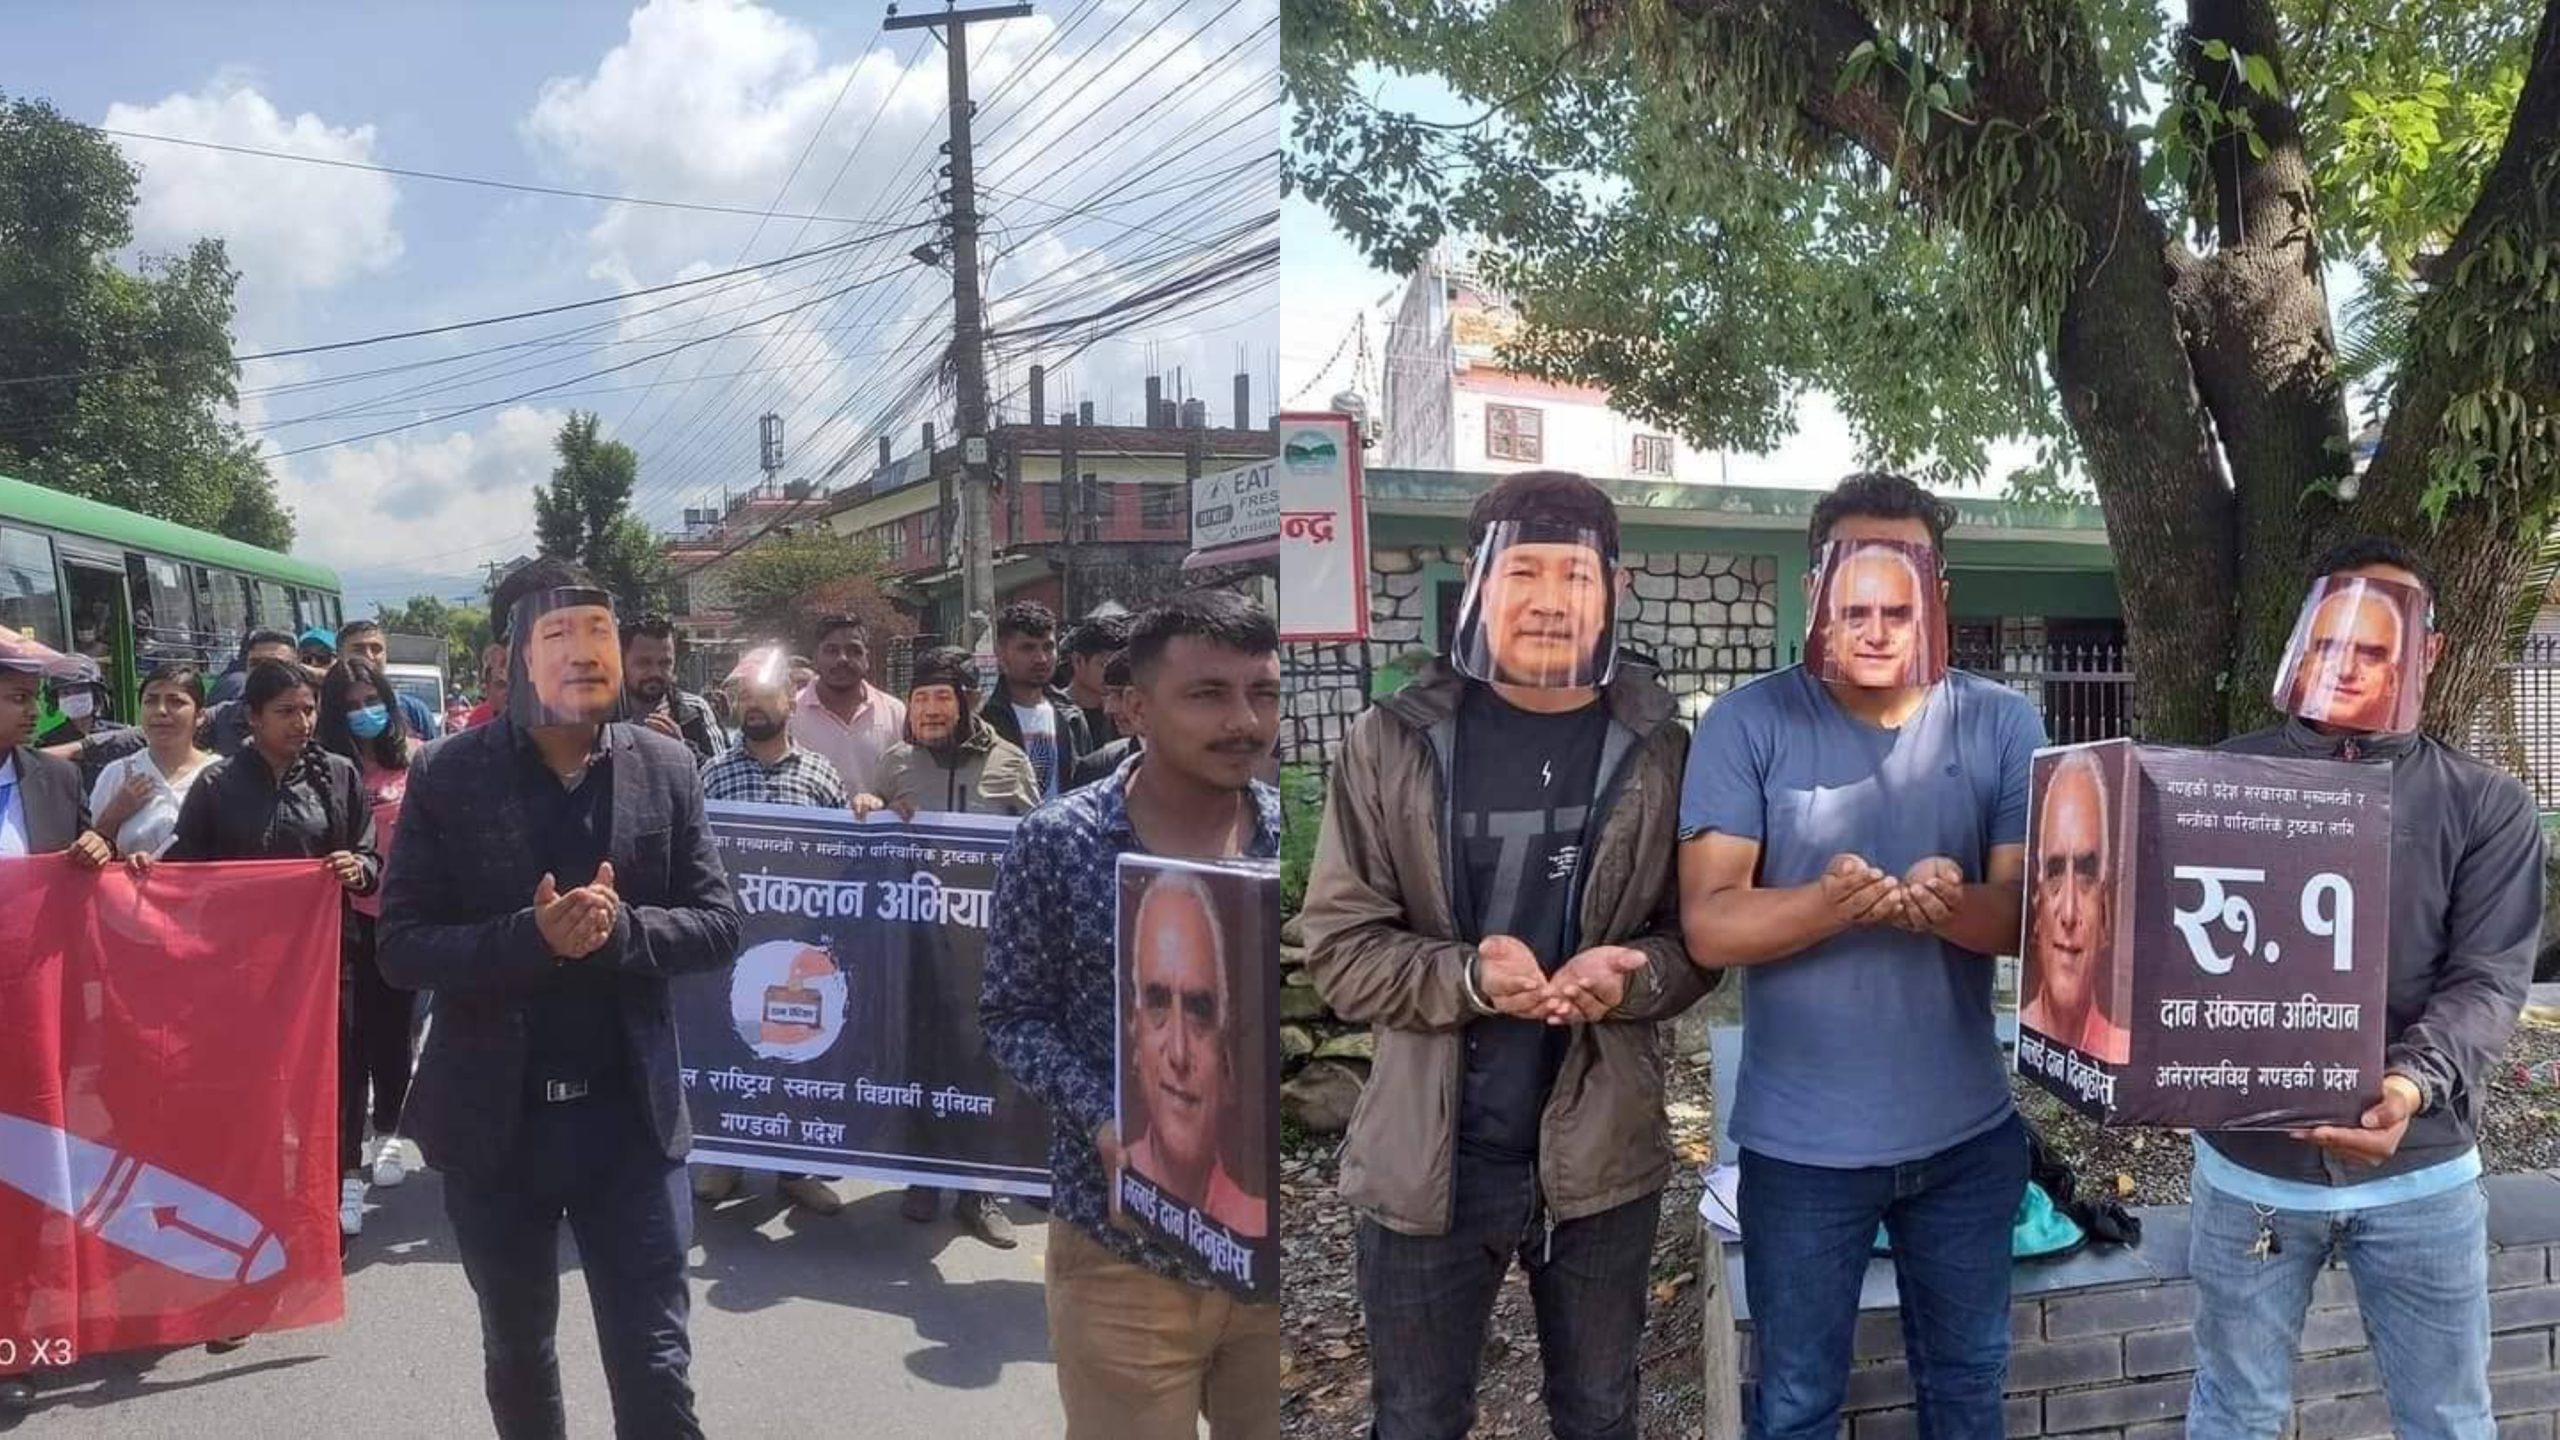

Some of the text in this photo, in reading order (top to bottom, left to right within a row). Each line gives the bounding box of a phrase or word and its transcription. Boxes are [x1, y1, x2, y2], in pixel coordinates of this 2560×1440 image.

[1234, 464, 1274, 494] EAT
[1280, 512, 1337, 544] न्द्र
[2213, 780, 2238, 800] प्रदेश
[738, 866, 867, 918] संकलन
[2301, 872, 2353, 971] १
[2161, 993, 2361, 1031] दान संकलन अभियान
[2258, 1060, 2315, 1089] गण्डकी
[2322, 1063, 2360, 1091] प्रदेश
[707, 1066, 775, 1099] राष्ट्रिय
[783, 1077, 846, 1100] स्वतन्त्र
[931, 1086, 996, 1118] युनियन
[720, 1112, 847, 1144] गण्डकी प्रदेश
